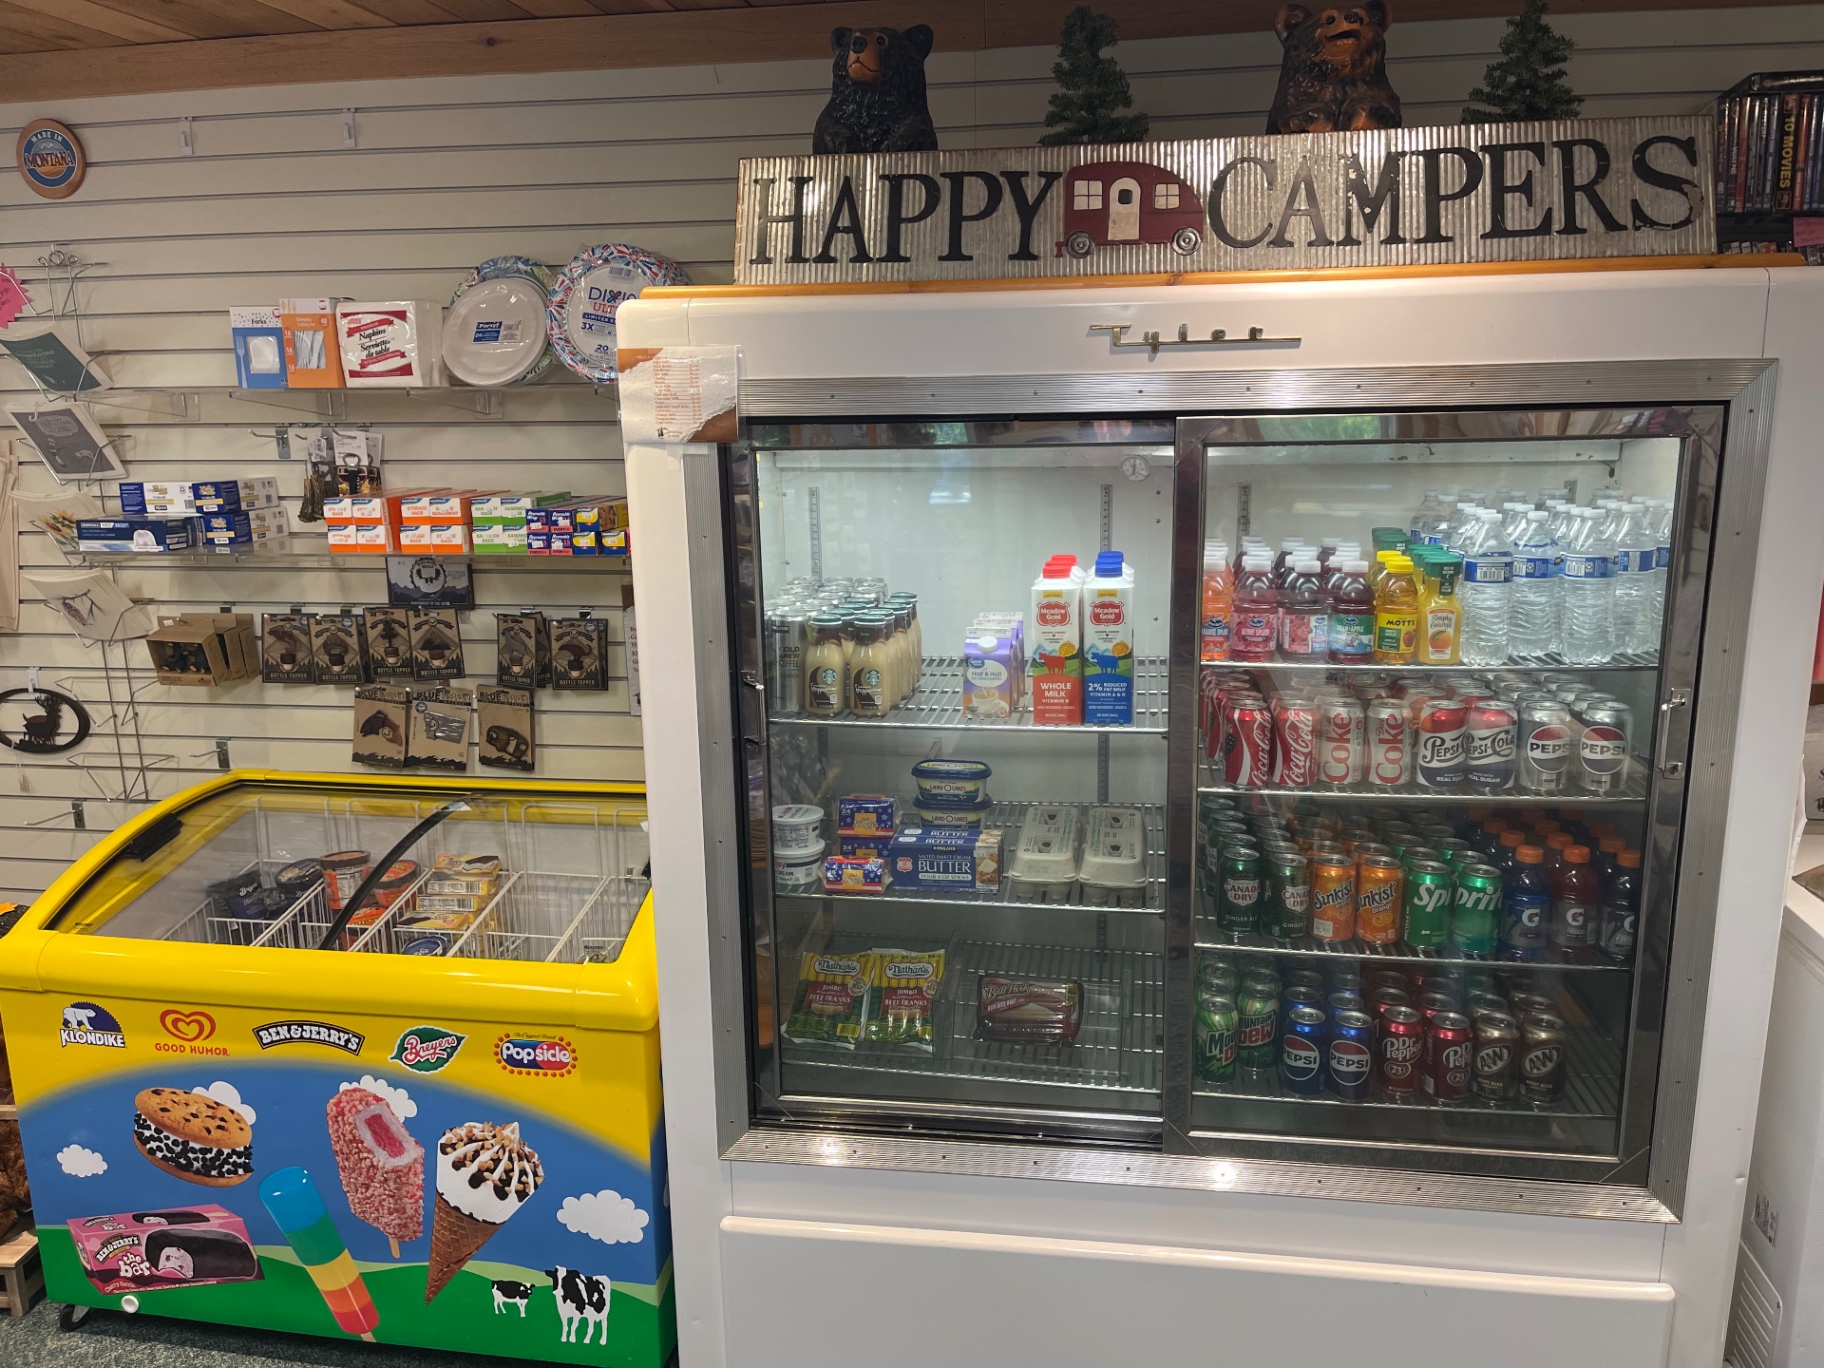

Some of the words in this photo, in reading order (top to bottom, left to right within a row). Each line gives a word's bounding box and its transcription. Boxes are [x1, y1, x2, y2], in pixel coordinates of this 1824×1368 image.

[1784, 117, 1795, 131] 10
[31, 131, 51, 143] MADE
[54, 133, 63, 142] IN
[25, 150, 75, 169] MONTANA
[1779, 136, 1795, 188] MOVIES
[749, 170, 1063, 265] HAPPY
[1208, 135, 1705, 249] CAMPERS
[581, 322, 595, 332] 3X
[359, 328, 386, 341] Napkins
[597, 344, 609, 352] 20
[1094, 607, 1120, 615] Meadow
[1099, 613, 1115, 621] Gold
[1431, 614, 1453, 624] Simply
[1040, 682, 1072, 690] WHOLE
[1088, 683, 1103, 692] 2%
[416, 691, 440, 700] BLUE
[1045, 690, 1066, 698] MILK
[1325, 717, 1333, 736] Diet
[1377, 718, 1385, 737] Diet
[1251, 710, 1272, 786] Coca-Cola
[1282, 709, 1313, 786] Coca-Cola
[1322, 712, 1353, 784] Coke
[1376, 713, 1405, 785] Coke
[1581, 742, 1626, 756] PEPSI
[1479, 776, 1501, 784] SUGAR
[929, 784, 944, 792] LAND
[943, 784, 952, 792] O
[952, 784, 966, 792] LAKES
[945, 815, 954, 823] O
[918, 860, 971, 873] BUTTER
[1233, 892, 1254, 902] DRY
[1313, 879, 1354, 910] Sunkist
[1371, 902, 1393, 914] Orange
[1225, 914, 1248, 922] GINGER
[1521, 908, 1541, 927] G
[1566, 908, 1585, 926] G
[819, 960, 858, 972] Nathan's
[888, 964, 930, 976] Nathan's
[822, 984, 843, 992] JUMBO
[809, 993, 825, 1002] BEEF
[824, 995, 851, 1003] FRANKS
[60, 1028, 126, 1048] KLONDIKE
[258, 1023, 359, 1051] BEN&JERRY'S
[1399, 1036, 1415, 1049] Dr
[155, 1042, 186, 1053] GOOD
[190, 1046, 229, 1057] HUMOR
[402, 1034, 457, 1065] Breyers
[501, 1042, 571, 1064] Popsicle
[1382, 1038, 1423, 1063] Pepper
[1331, 1052, 1369, 1068] PEPSI
[1528, 1048, 1556, 1071] A&W
[1391, 1064, 1402, 1075] 23
[1455, 1072, 1465, 1082] 23
[96, 1234, 139, 1263] BEN&JERRY'S
[122, 1252, 142, 1265] the
[118, 1259, 151, 1278] bar
[104, 1281, 120, 1293] Cherry
